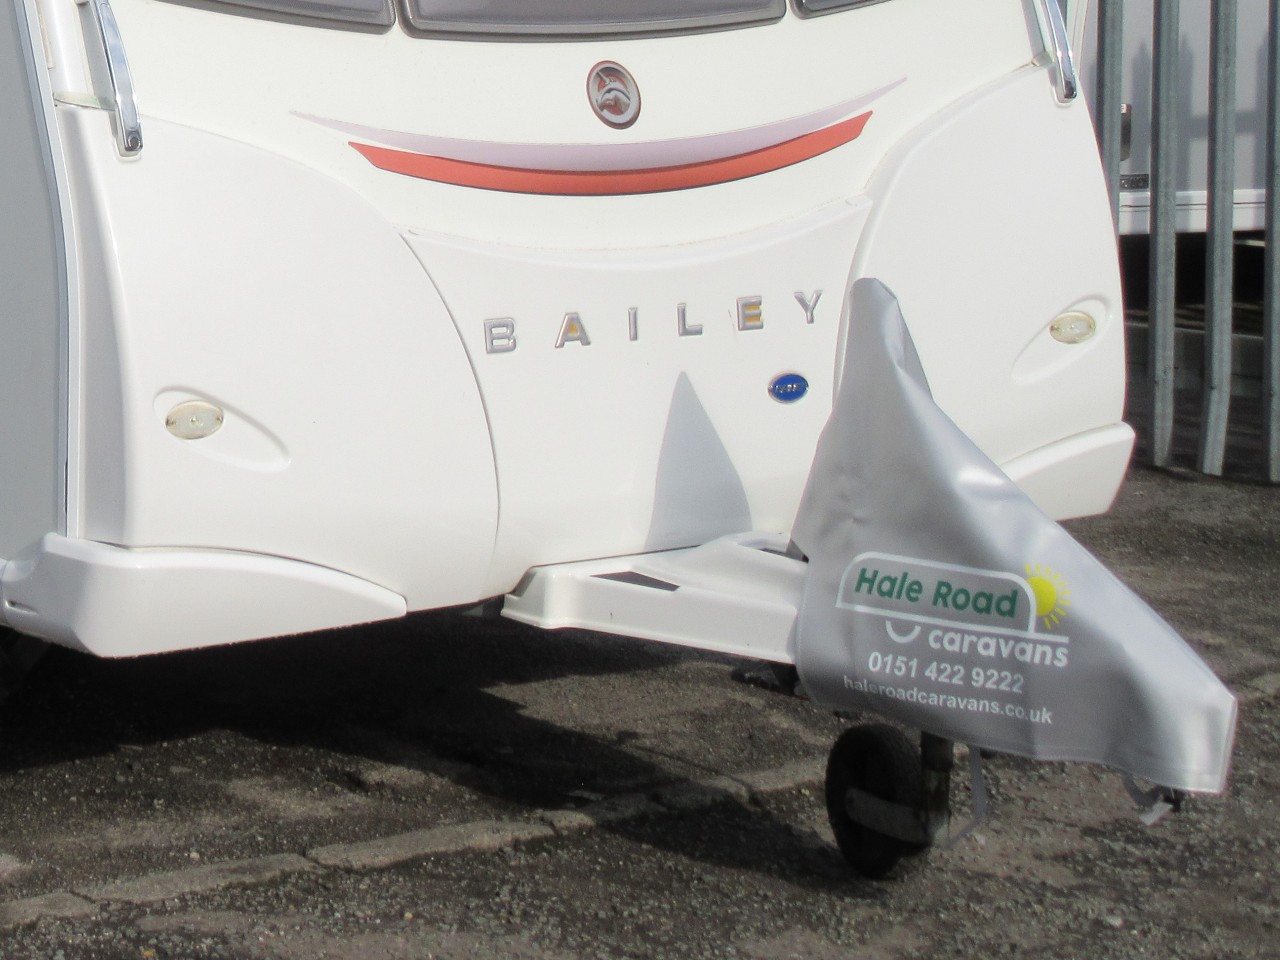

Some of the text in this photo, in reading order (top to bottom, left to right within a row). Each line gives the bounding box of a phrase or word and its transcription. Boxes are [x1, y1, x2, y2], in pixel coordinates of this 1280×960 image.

[483, 289, 824, 355] BAILEY
[855, 567, 1019, 618] Hale Road
[928, 629, 1069, 667] caravans
[868, 651, 1025, 695] 0151 422 9222
[843, 675, 1053, 724] haleroadcaravans.co.uk
